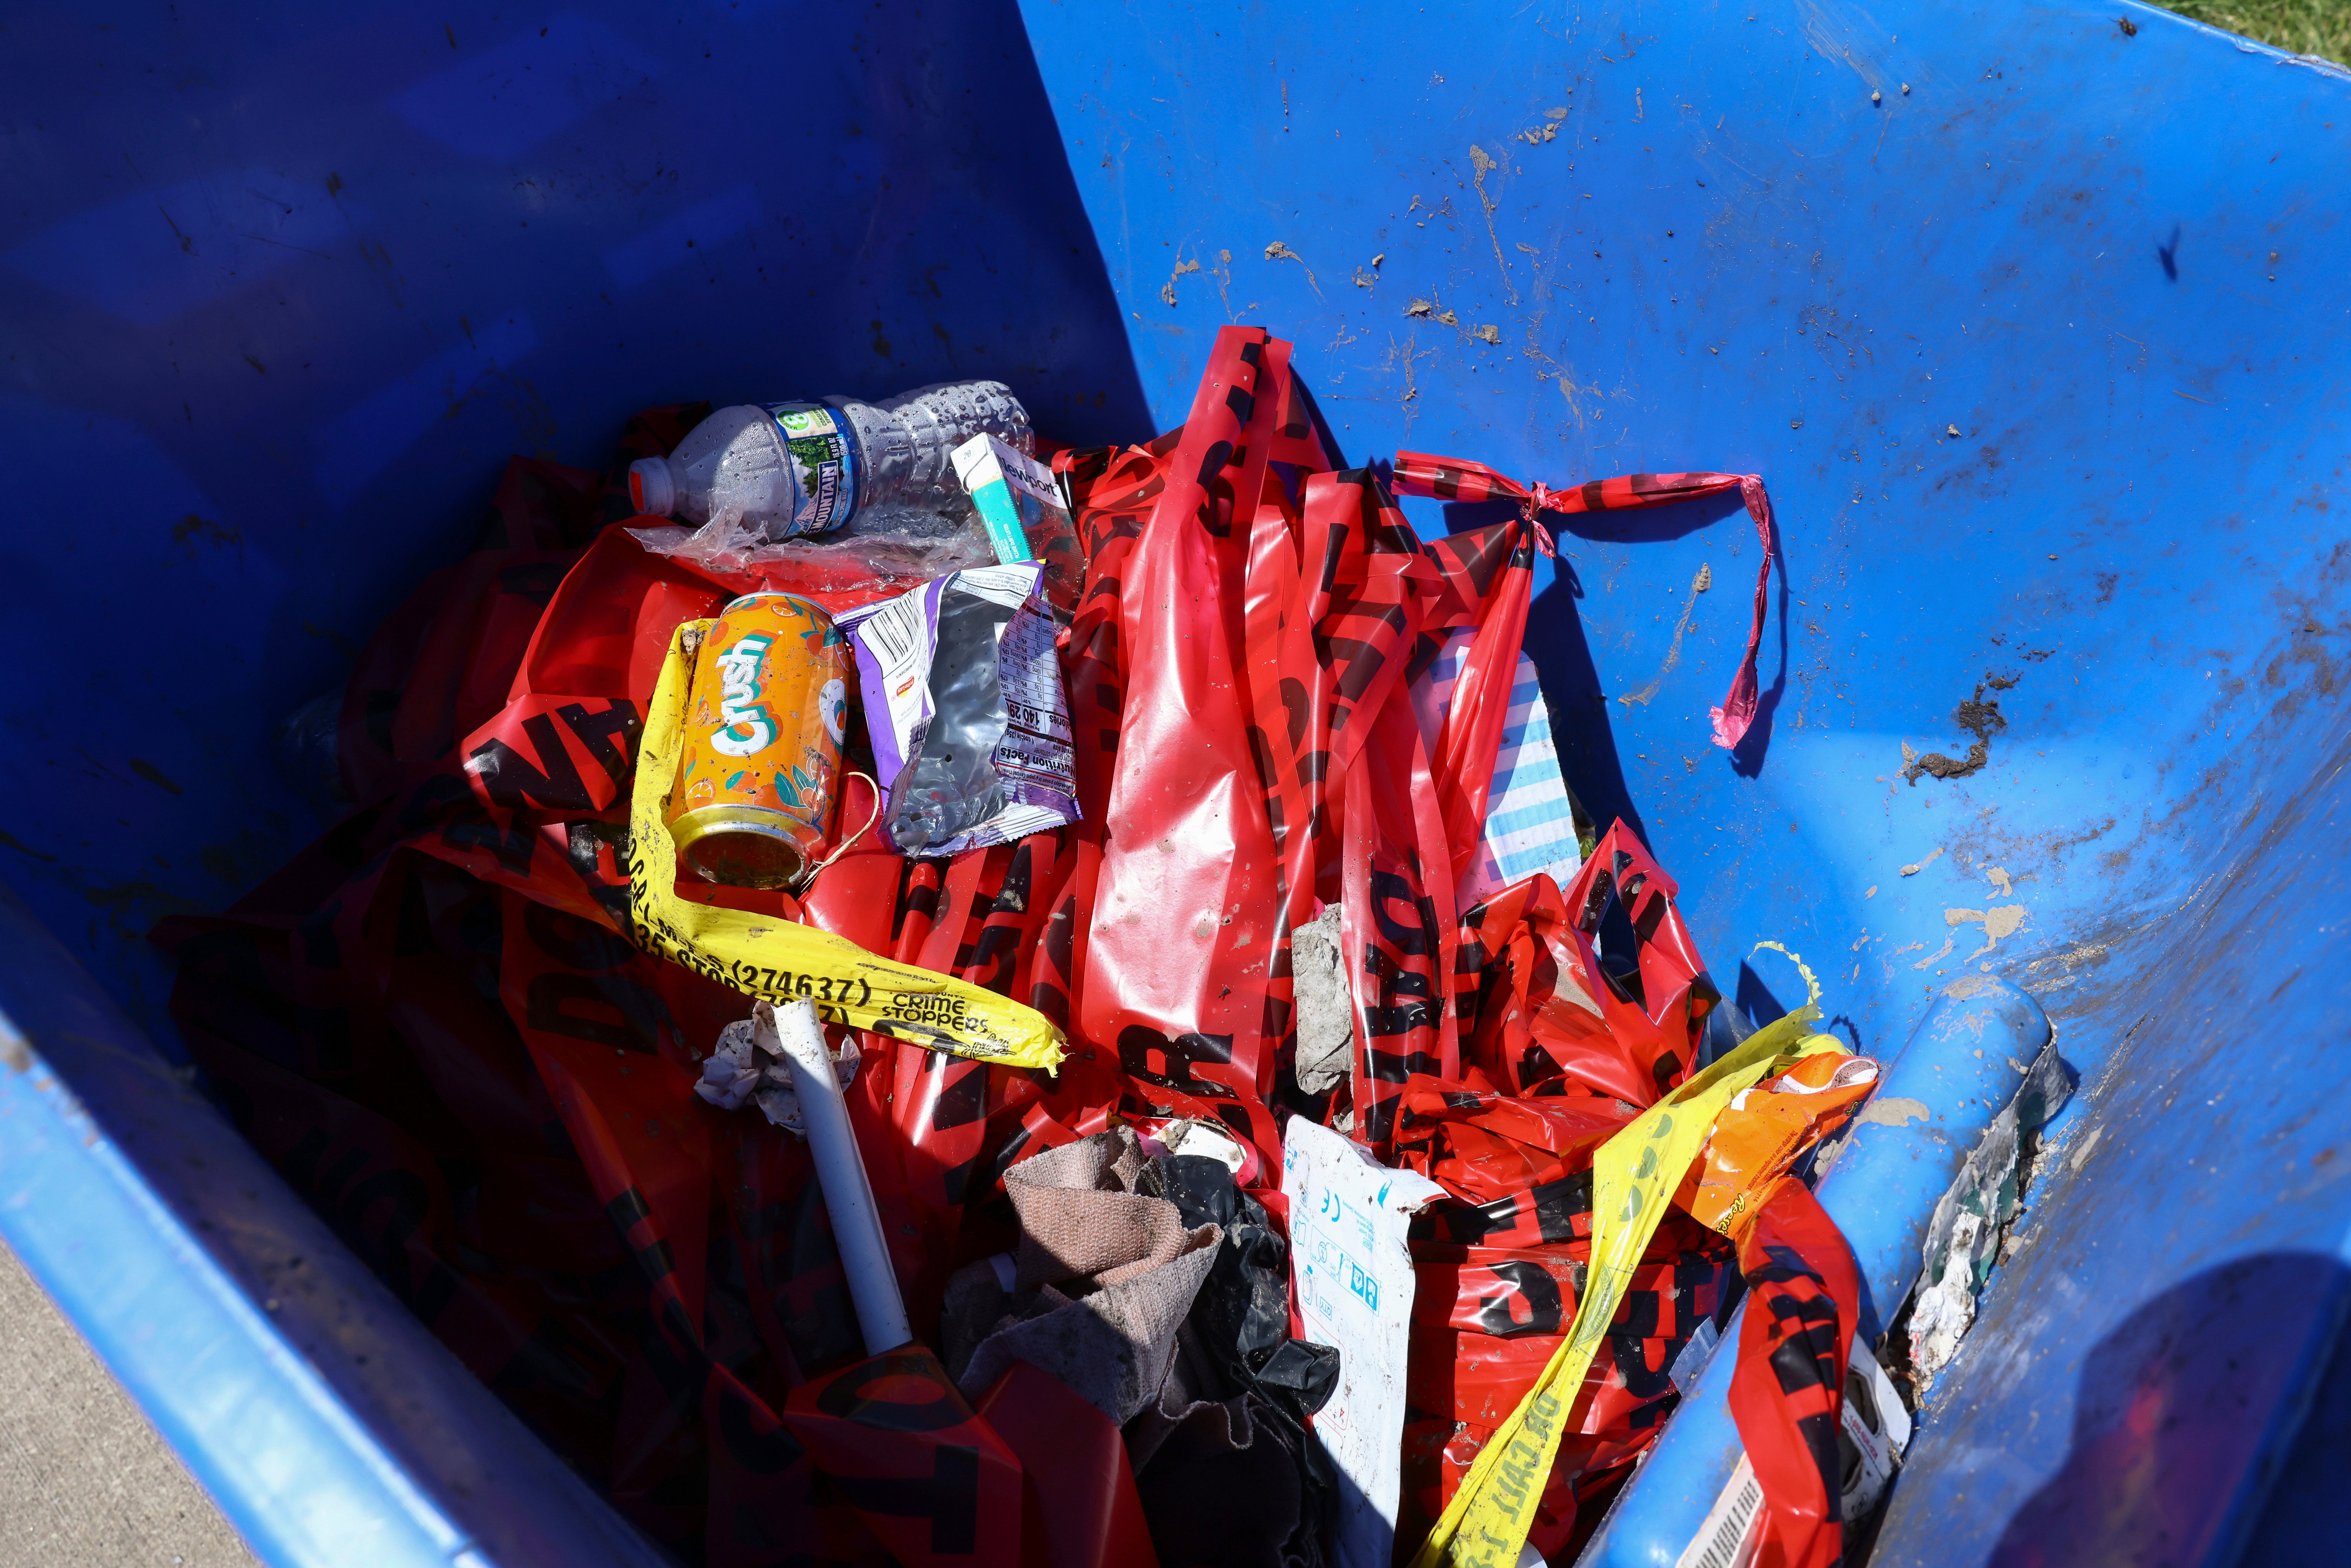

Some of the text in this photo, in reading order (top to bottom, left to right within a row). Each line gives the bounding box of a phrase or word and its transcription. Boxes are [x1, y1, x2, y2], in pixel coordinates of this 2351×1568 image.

[809, 412, 822, 428] HELPING
[837, 436, 849, 456] (500 mL)
[964, 450, 971, 459] 20
[997, 454, 1056, 497] Newport
[815, 465, 835, 530] MOUNTAIN
[1003, 523, 1011, 535] LITTER
[1011, 545, 1020, 558] PLEASE
[1004, 592, 1024, 602] Potassium
[1042, 628, 1053, 636] Sugars
[1010, 650, 1020, 659] 290mg
[1030, 657, 1041, 666] 150mg
[895, 664, 913, 679] INGREDIENTS.
[1032, 666, 1041, 674] 10mg
[710, 639, 768, 756] Crush
[1022, 708, 1039, 725] 140
[1048, 715, 1069, 729] alories
[1004, 728, 1017, 738] (35g)
[1017, 732, 1031, 742] cookie
[1034, 747, 1050, 756] container
[1061, 746, 1073, 755] erving
[1000, 747, 1075, 777] Nutrition Facts
[1054, 781, 1071, 789] Weekdays
[732, 959, 871, 1007] (274637)
[893, 995, 965, 1015] CRIME
[882, 1006, 988, 1033] STOPPERS
[1789, 1129, 1798, 1138] The
[1780, 1135, 1792, 1148] orange
[1774, 1146, 1784, 1156] color
[1757, 1158, 1773, 1177] registered
[1745, 1174, 1760, 1192] trademark.
[1342, 1200, 1353, 1212] Germany
[1715, 1193, 1746, 1236] Reese's
[1358, 1228, 1368, 1236] GmbH
[1320, 1303, 1330, 1315] QTY
[1337, 1406, 1345, 1418] 4
